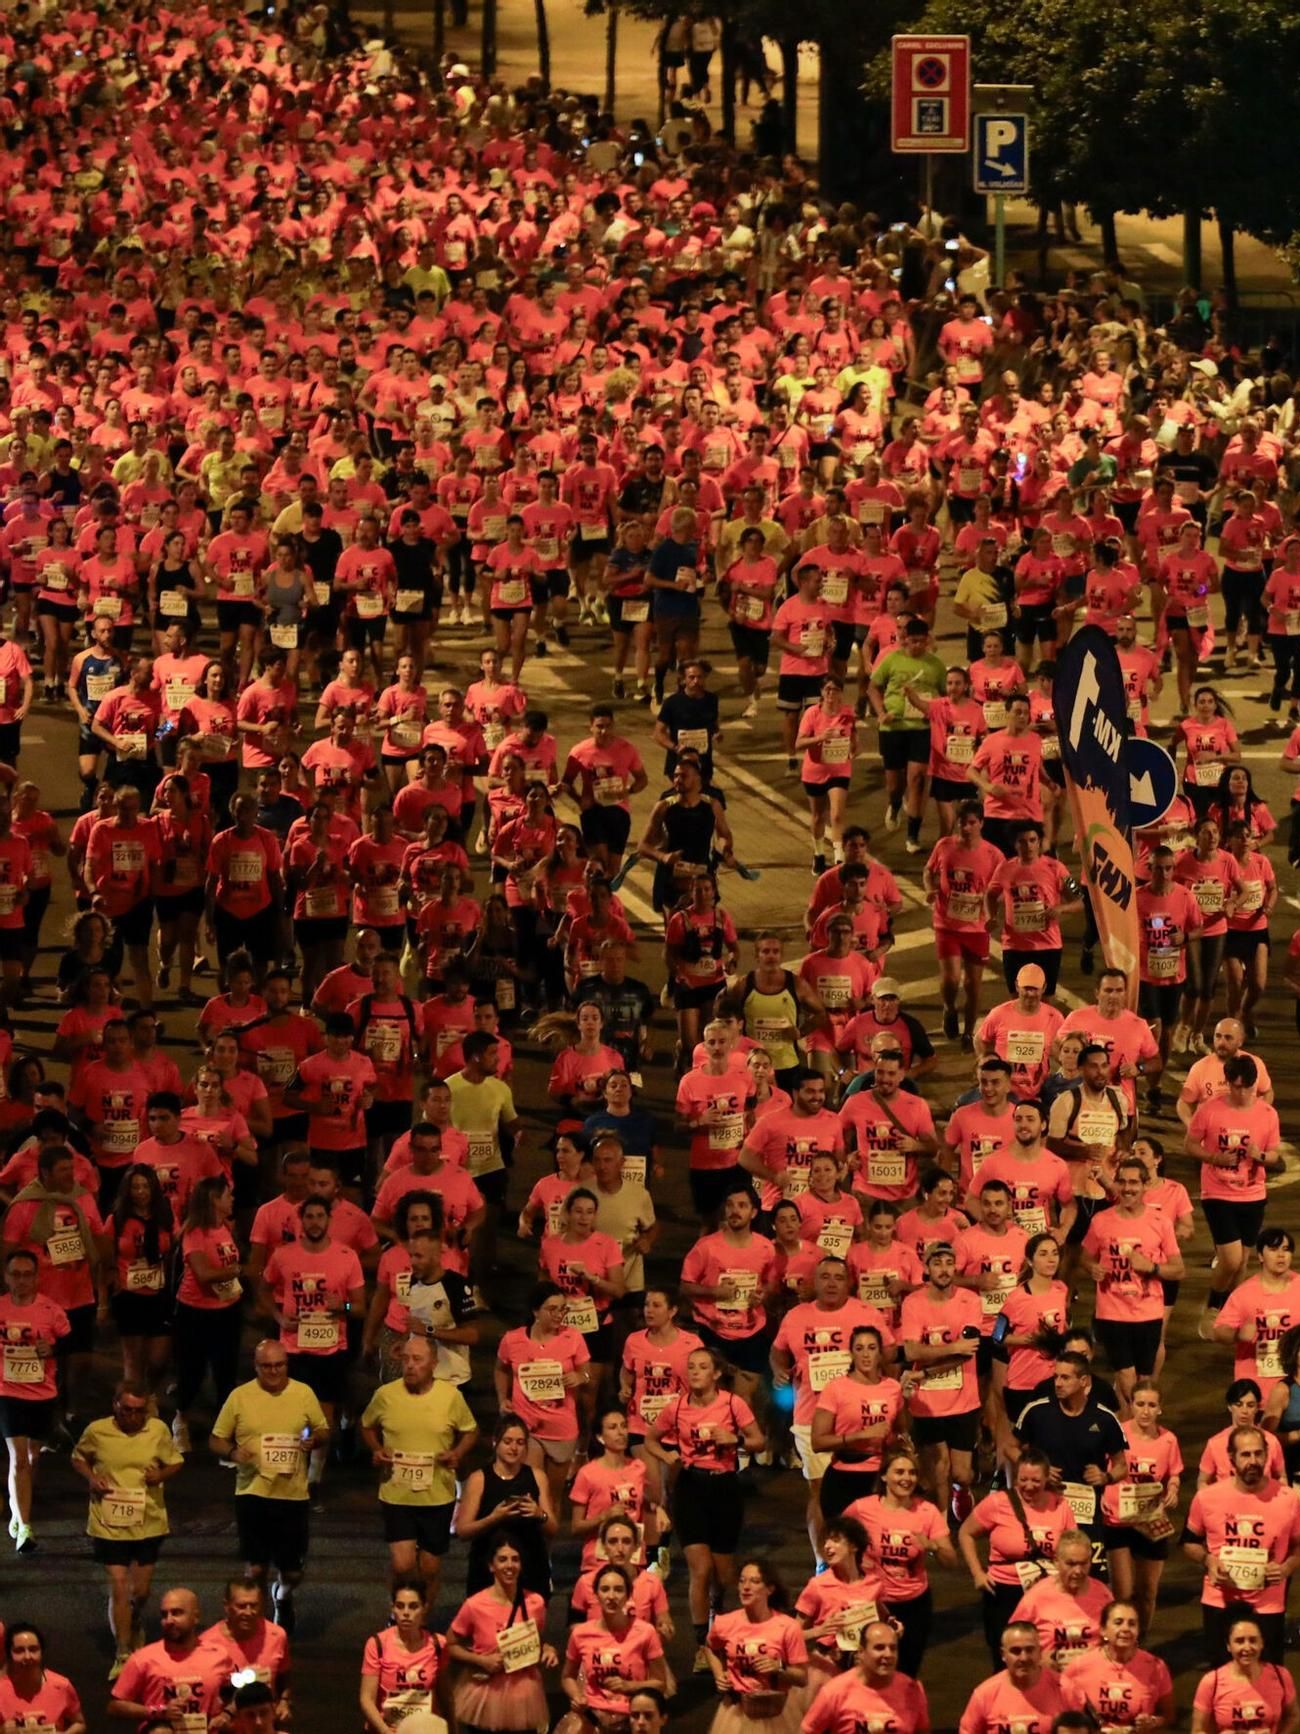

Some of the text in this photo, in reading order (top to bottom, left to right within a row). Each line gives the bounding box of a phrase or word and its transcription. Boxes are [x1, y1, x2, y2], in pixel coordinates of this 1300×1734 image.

[986, 120, 1017, 157] P
[1004, 765, 1026, 775] TUR
[1004, 775, 1020, 785] NA
[1016, 1046, 1034, 1057] 925
[102, 1108, 131, 1120] TUR
[106, 1133, 138, 1145] 0948
[868, 1139, 898, 1150] TUR
[870, 1166, 902, 1177] 15031
[787, 1183, 806, 1194] 147
[55, 1241, 82, 1254] 5859
[824, 1237, 840, 1248] 935
[1111, 1270, 1132, 1282] NA
[293, 1294, 325, 1306] TUR
[866, 1289, 887, 1300] 280
[986, 1292, 1007, 1304] 280
[304, 1327, 333, 1339] 4920
[9, 1362, 39, 1373] 7776
[523, 1379, 560, 1390] 12824
[644, 1378, 670, 1387] TUR
[642, 1411, 658, 1423] 12
[401, 1468, 423, 1480] 719
[111, 1504, 134, 1516] 718
[1068, 1501, 1093, 1514] 886
[1227, 1566, 1258, 1578] 7764
